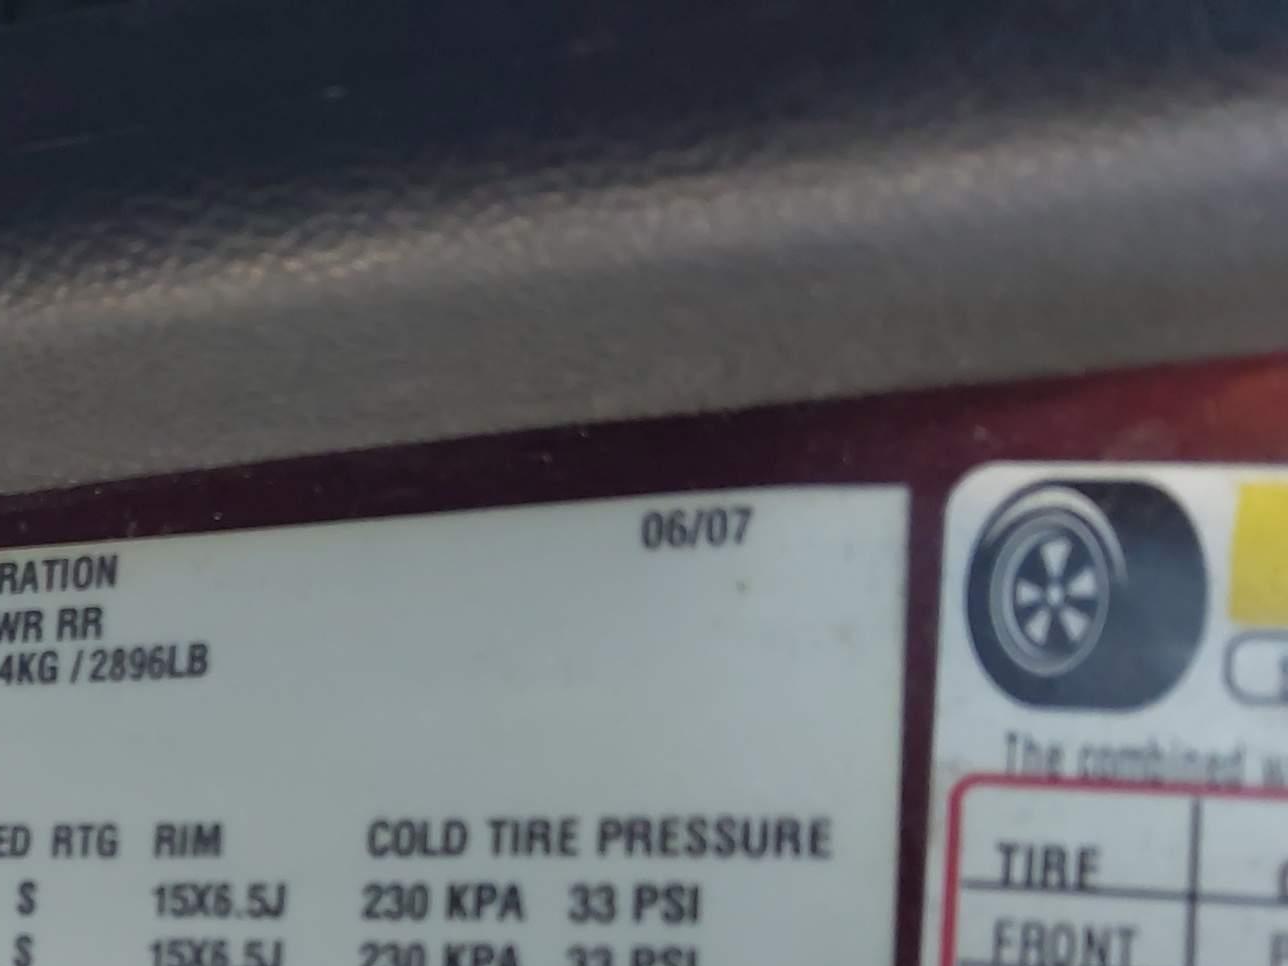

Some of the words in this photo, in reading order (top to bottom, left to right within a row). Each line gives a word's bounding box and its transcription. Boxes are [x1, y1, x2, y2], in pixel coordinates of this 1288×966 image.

[641, 506, 753, 548] 06/07
[56, 606, 104, 641] RR
[51, 824, 119, 858] RTG
[154, 823, 224, 859] RIM
[367, 818, 468, 859] COLD
[489, 818, 579, 859] TIRE
[597, 818, 834, 859] PRESSURE
[995, 842, 1101, 891] TIRE
[17, 880, 37, 916] S
[153, 882, 288, 919] 15X6.5J
[362, 882, 430, 921] 230
[446, 882, 526, 921] KPA
[569, 883, 619, 923] 33
[634, 884, 701, 924] PSI
